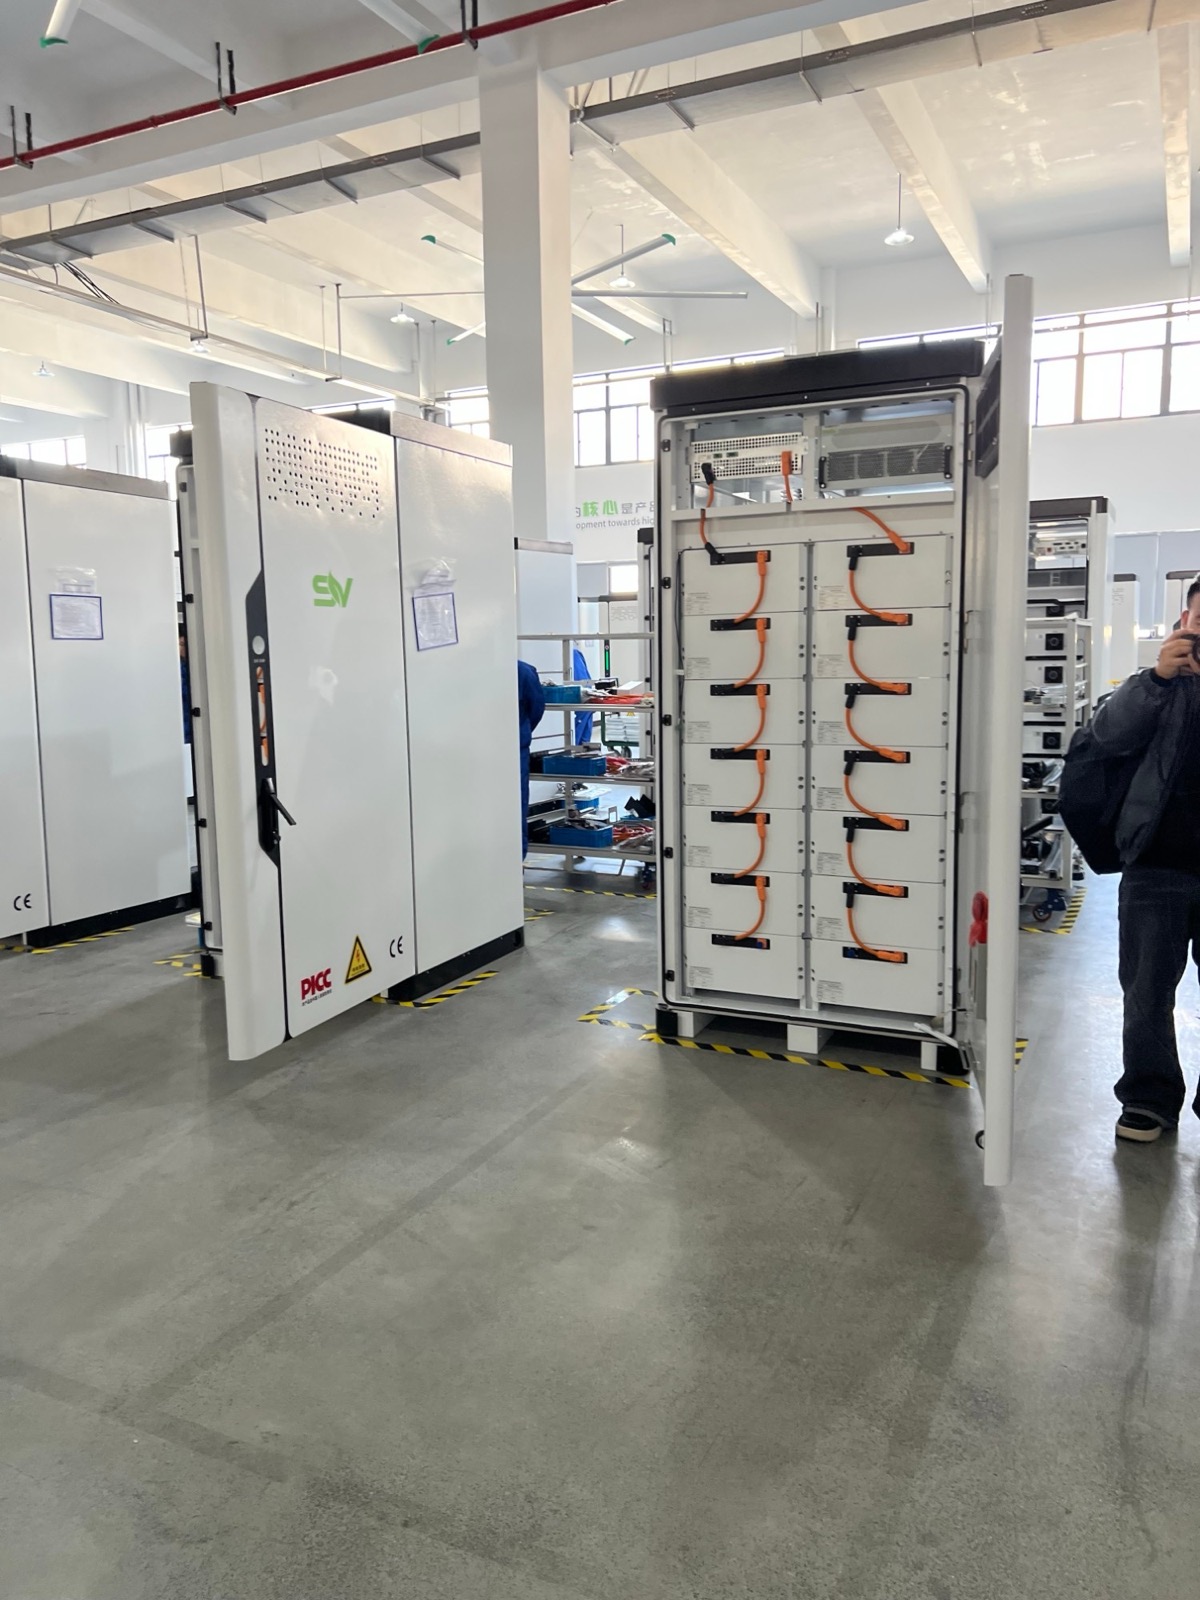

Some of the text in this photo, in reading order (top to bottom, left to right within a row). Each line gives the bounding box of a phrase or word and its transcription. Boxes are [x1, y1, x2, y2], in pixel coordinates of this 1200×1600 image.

[608, 517, 640, 526] towards
[13, 893, 32, 911] CE
[389, 935, 404, 958] CE
[301, 968, 332, 1001] PICC
